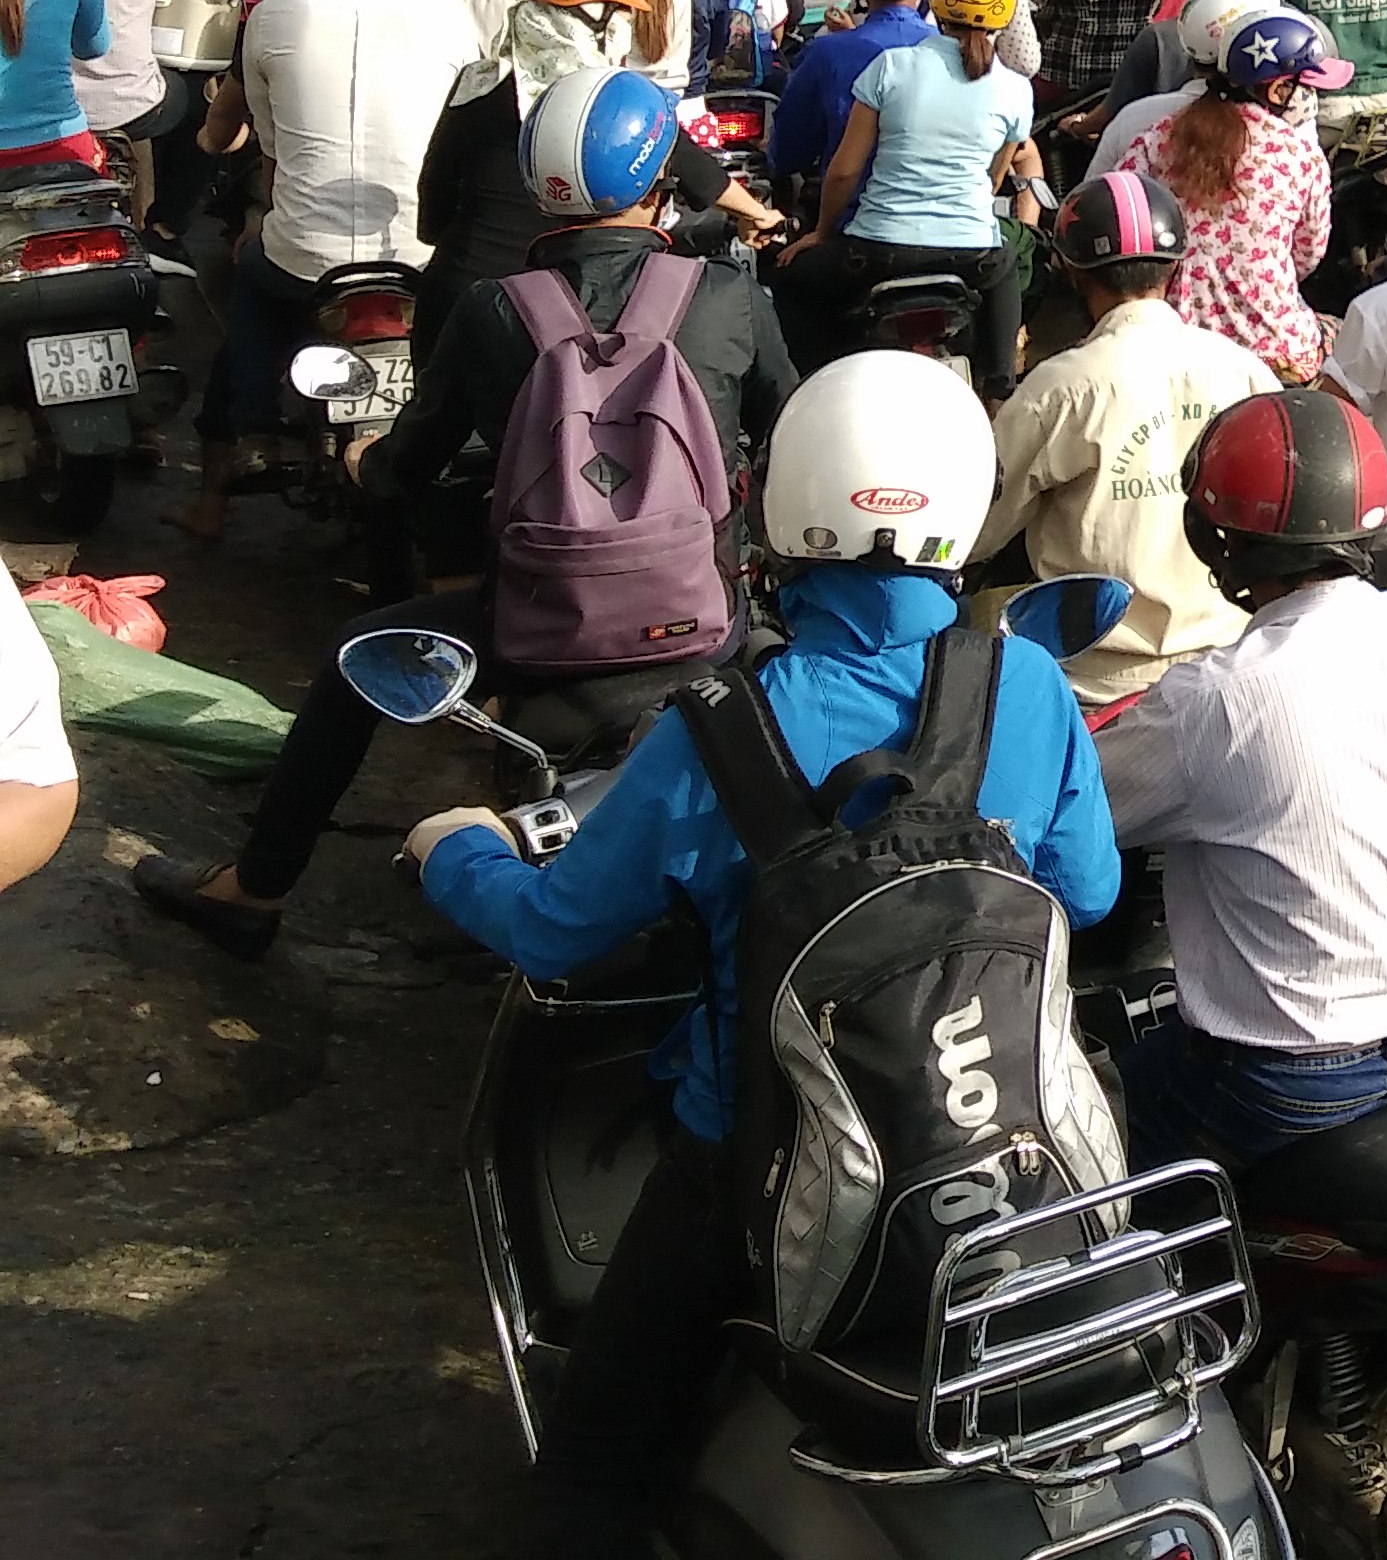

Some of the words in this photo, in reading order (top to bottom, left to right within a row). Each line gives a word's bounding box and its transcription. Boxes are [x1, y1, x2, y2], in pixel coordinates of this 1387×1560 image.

[45, 335, 114, 368] 59-C1
[41, 362, 131, 398] 269.82
[1182, 403, 1202, 420] XD
